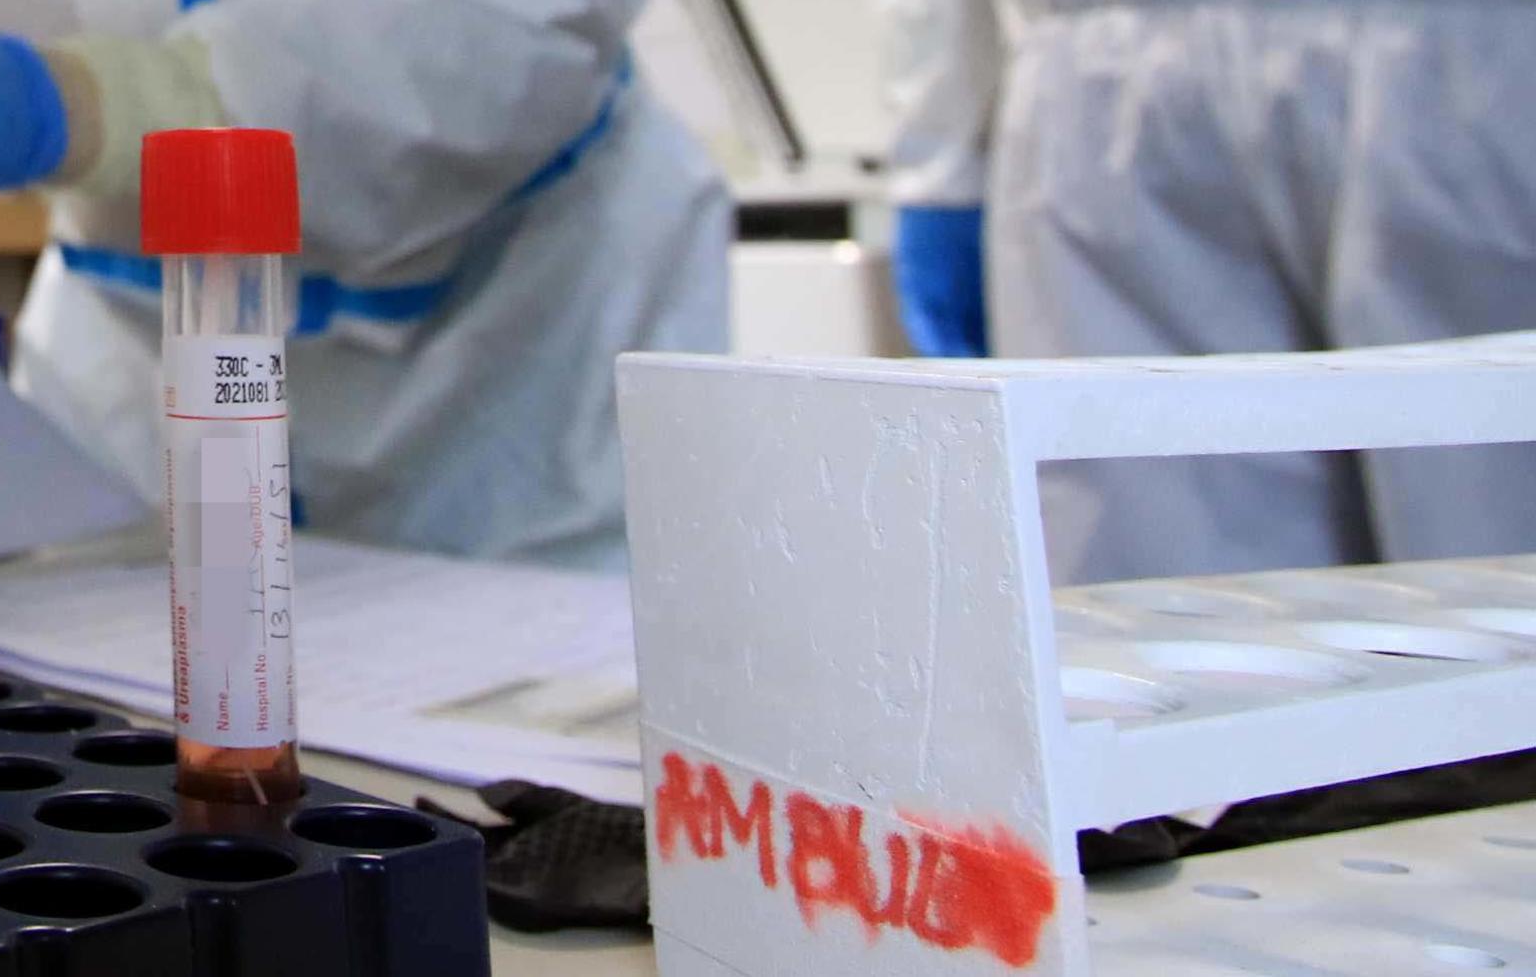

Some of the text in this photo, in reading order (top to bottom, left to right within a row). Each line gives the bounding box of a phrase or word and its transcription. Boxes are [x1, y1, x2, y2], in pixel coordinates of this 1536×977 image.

[176, 605, 193, 706] Ureaplasma
[254, 653, 271, 733] Hospital No
[215, 691, 231, 733] Name
